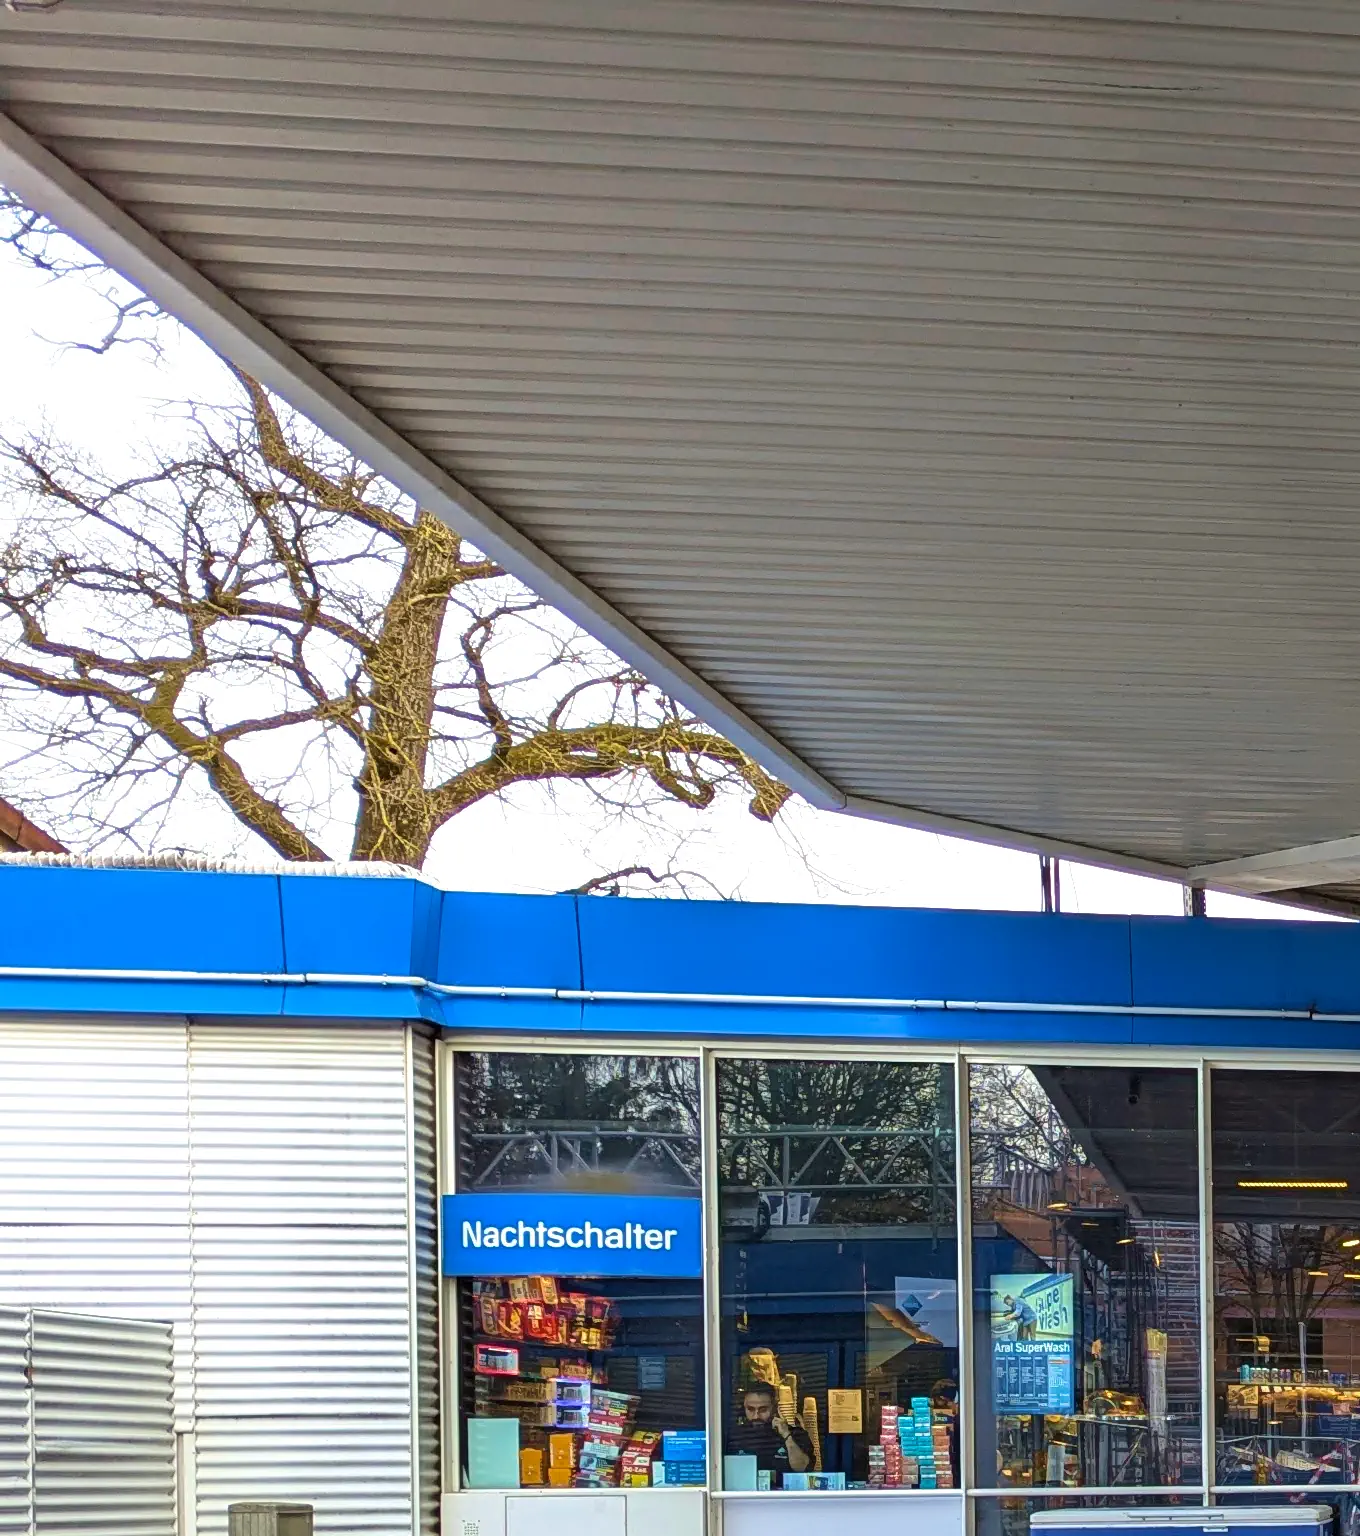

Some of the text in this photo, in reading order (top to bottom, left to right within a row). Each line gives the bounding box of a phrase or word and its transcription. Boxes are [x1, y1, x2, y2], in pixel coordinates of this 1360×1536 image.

[461, 1220, 678, 1250] Nachtschalter
[994, 1342, 1070, 1354] Aral SuperWash
